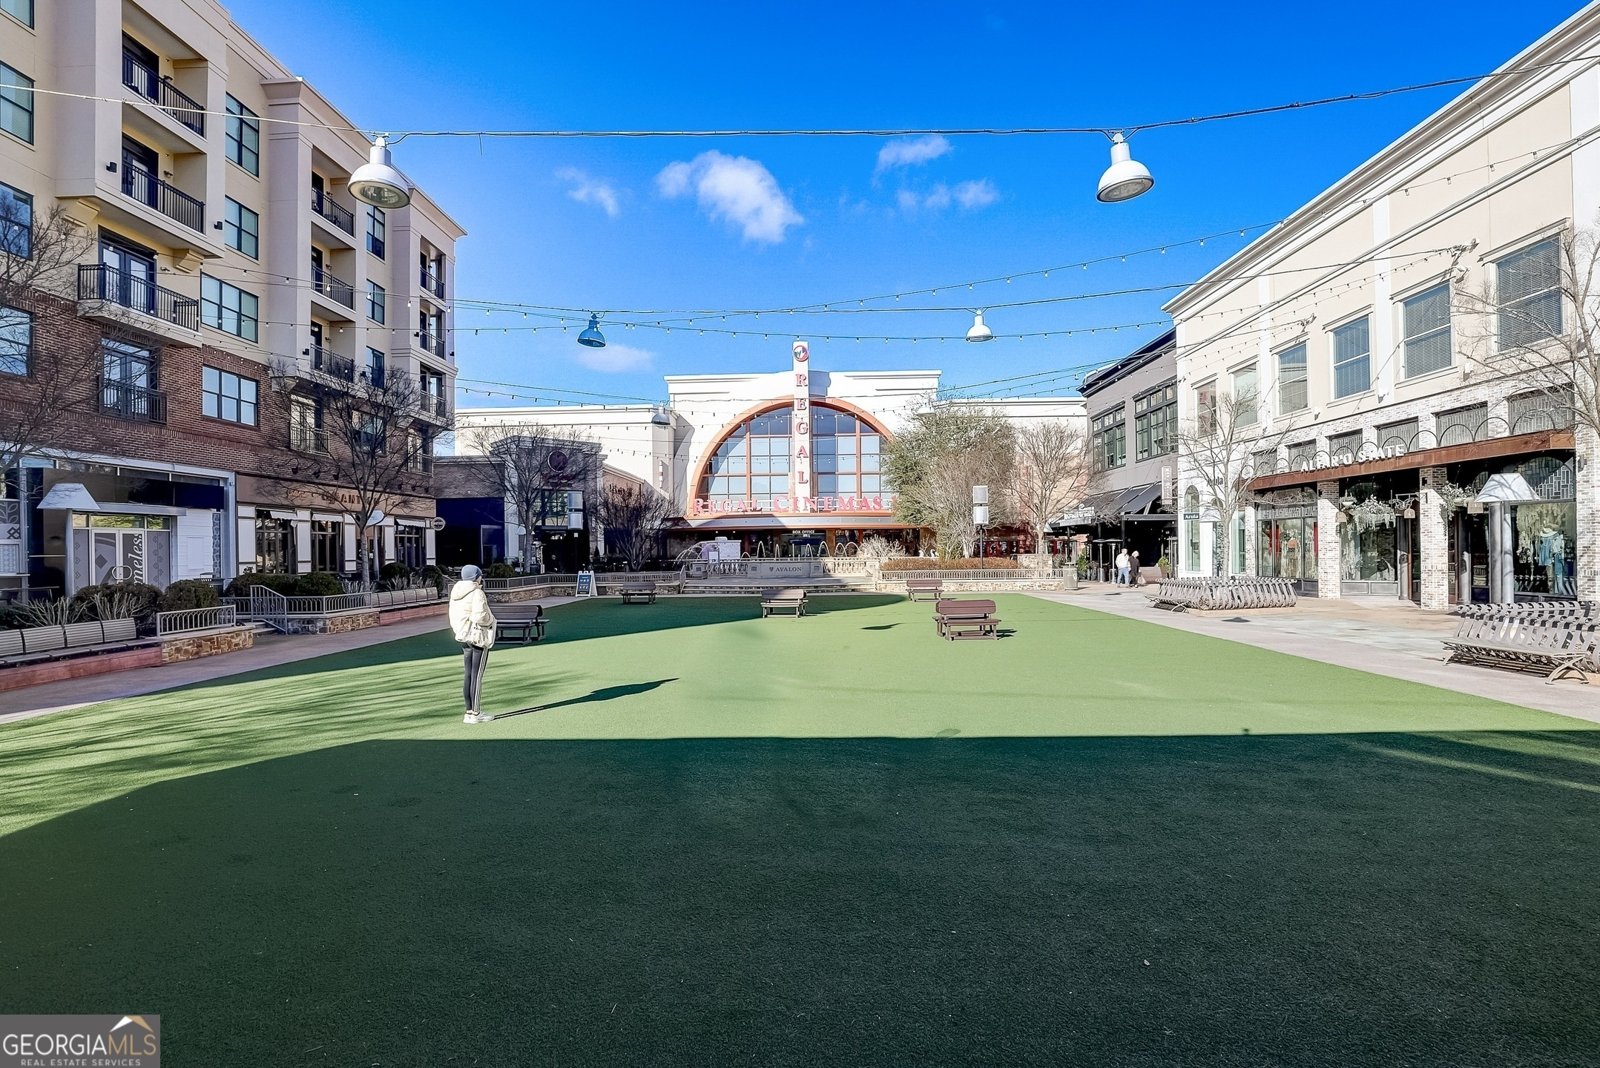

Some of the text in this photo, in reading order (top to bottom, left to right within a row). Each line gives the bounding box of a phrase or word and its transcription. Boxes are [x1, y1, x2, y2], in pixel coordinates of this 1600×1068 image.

[795, 373, 809, 484] REGAL
[692, 498, 763, 515] REGAL
[773, 495, 883, 513] CINEMAS
